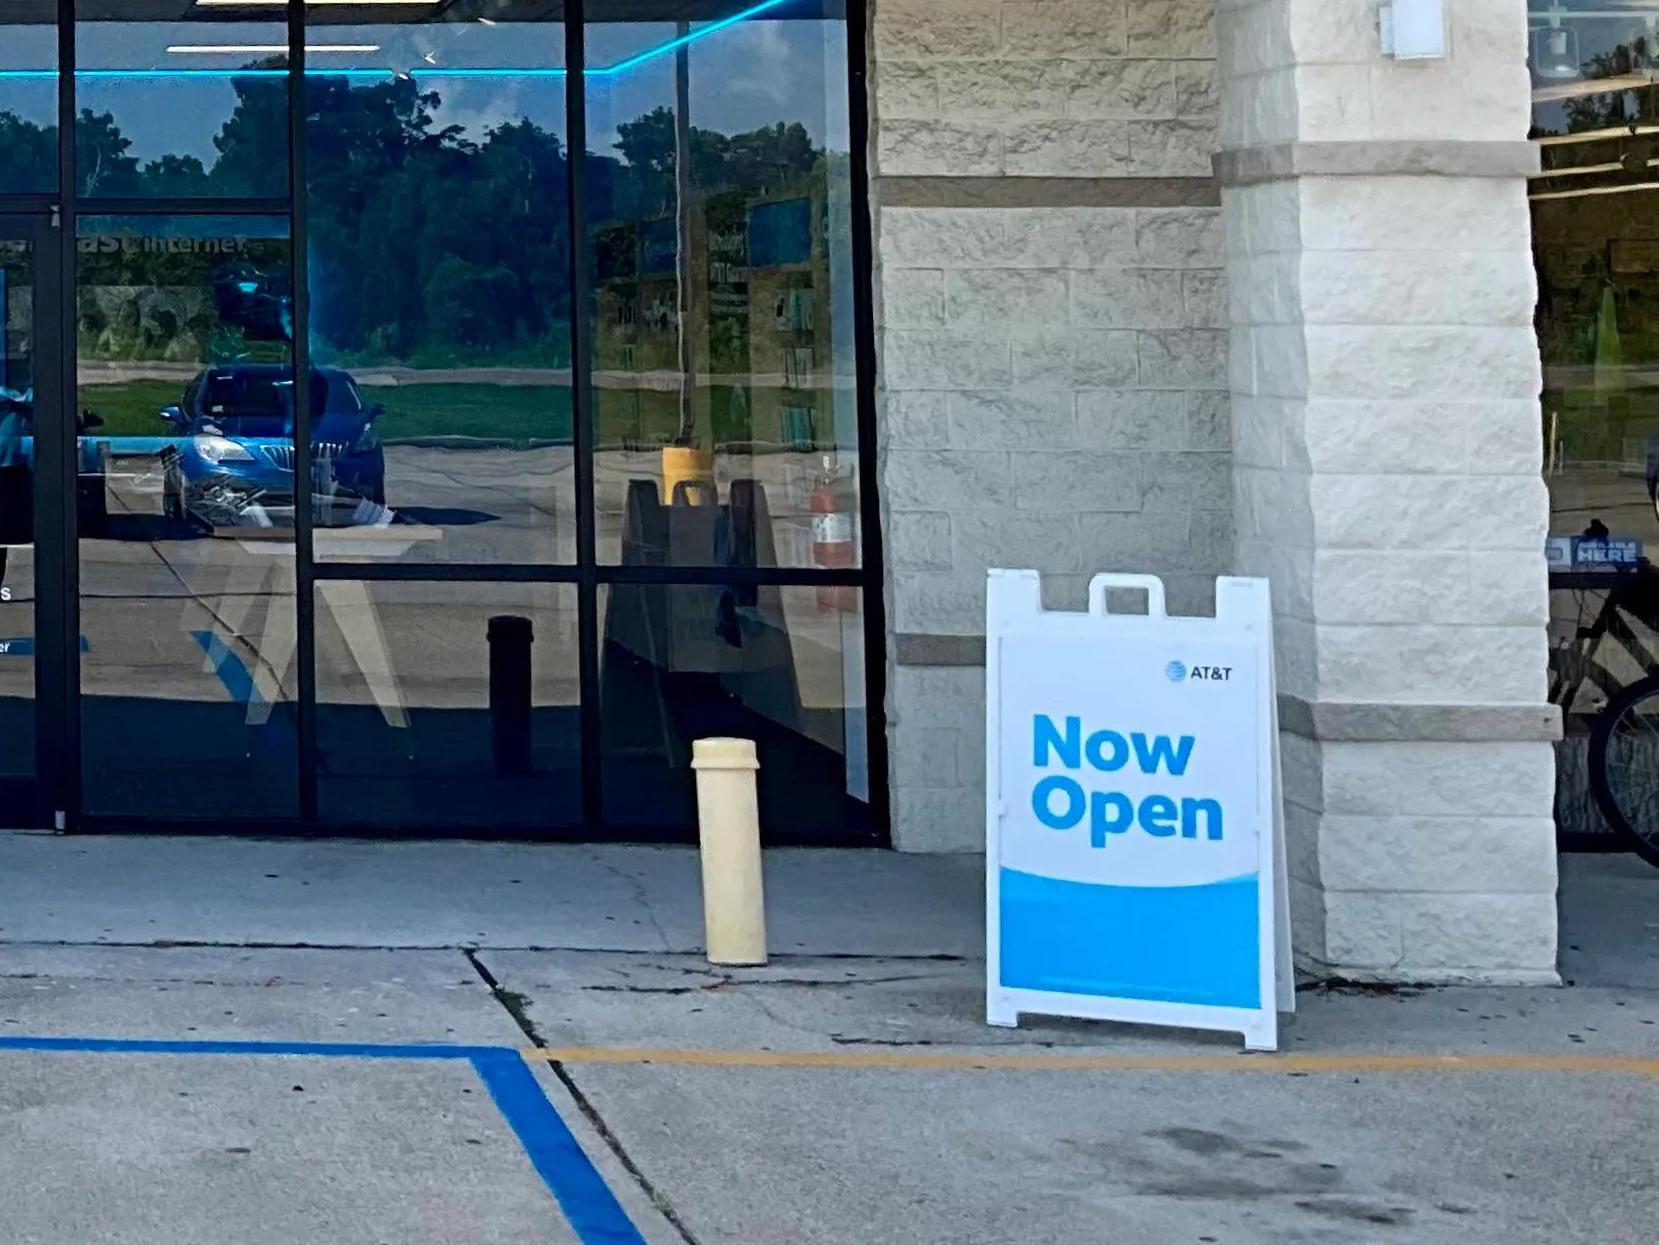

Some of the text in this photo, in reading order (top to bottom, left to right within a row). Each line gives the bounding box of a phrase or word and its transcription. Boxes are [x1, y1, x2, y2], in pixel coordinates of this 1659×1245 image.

[1577, 547, 1637, 563] HERE
[1190, 665, 1233, 681] AT&T
[1033, 713, 1195, 777] Now
[1031, 774, 1224, 849] Open
